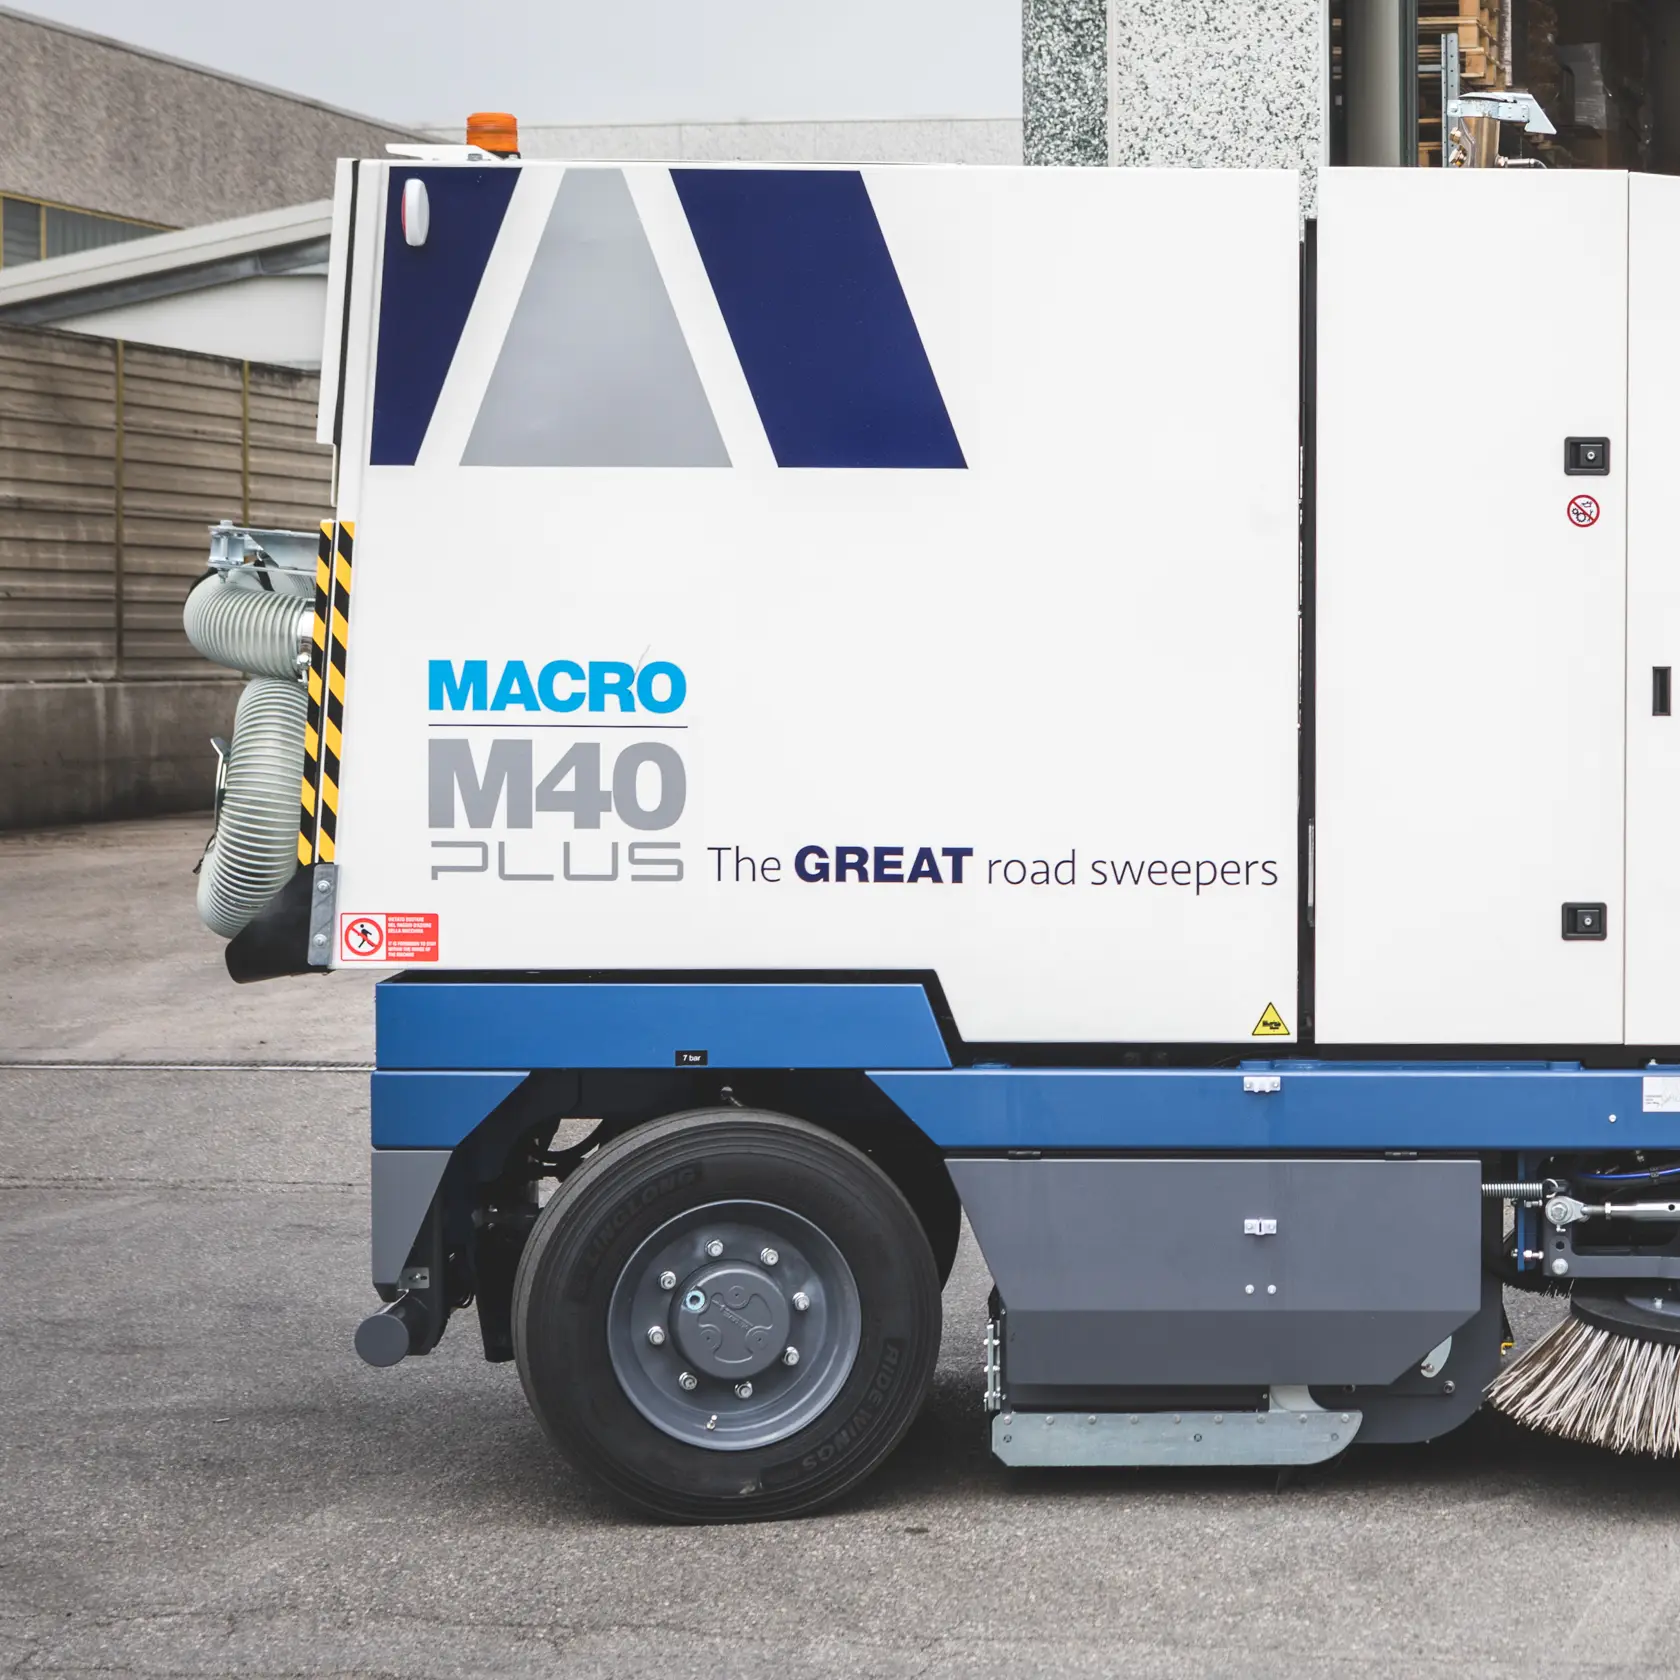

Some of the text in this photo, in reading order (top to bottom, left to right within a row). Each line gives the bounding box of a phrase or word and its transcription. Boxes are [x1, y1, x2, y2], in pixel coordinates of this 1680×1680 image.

[428, 660, 687, 715] MACRO
[428, 738, 687, 832] M40
[431, 841, 684, 882] PLUS
[707, 845, 1278, 896] The GREAT road sweepers
[682, 1054, 701, 1062] 7 bar
[588, 1166, 698, 1267] LINGLONG
